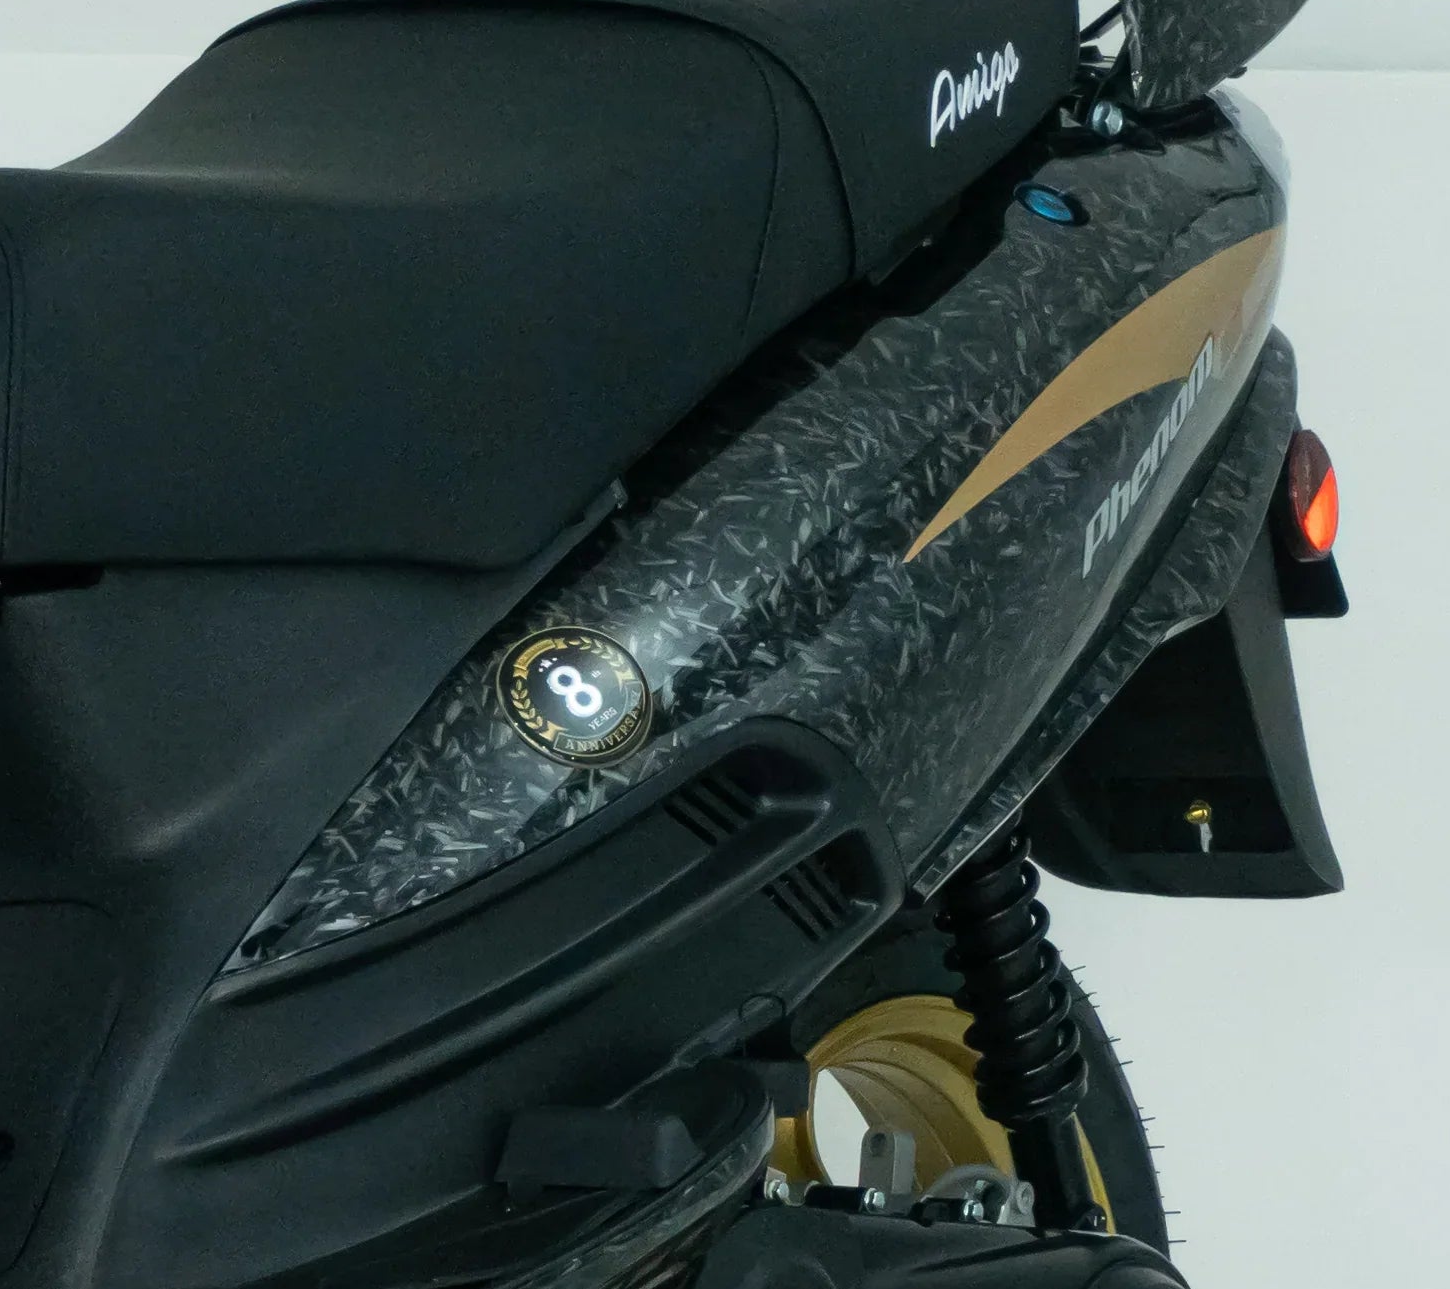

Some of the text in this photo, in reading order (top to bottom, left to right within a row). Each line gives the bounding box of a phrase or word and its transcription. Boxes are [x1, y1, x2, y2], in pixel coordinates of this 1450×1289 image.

[930, 41, 1019, 148] Amigo
[546, 665, 603, 718] 8
[588, 707, 618, 731] YEARS
